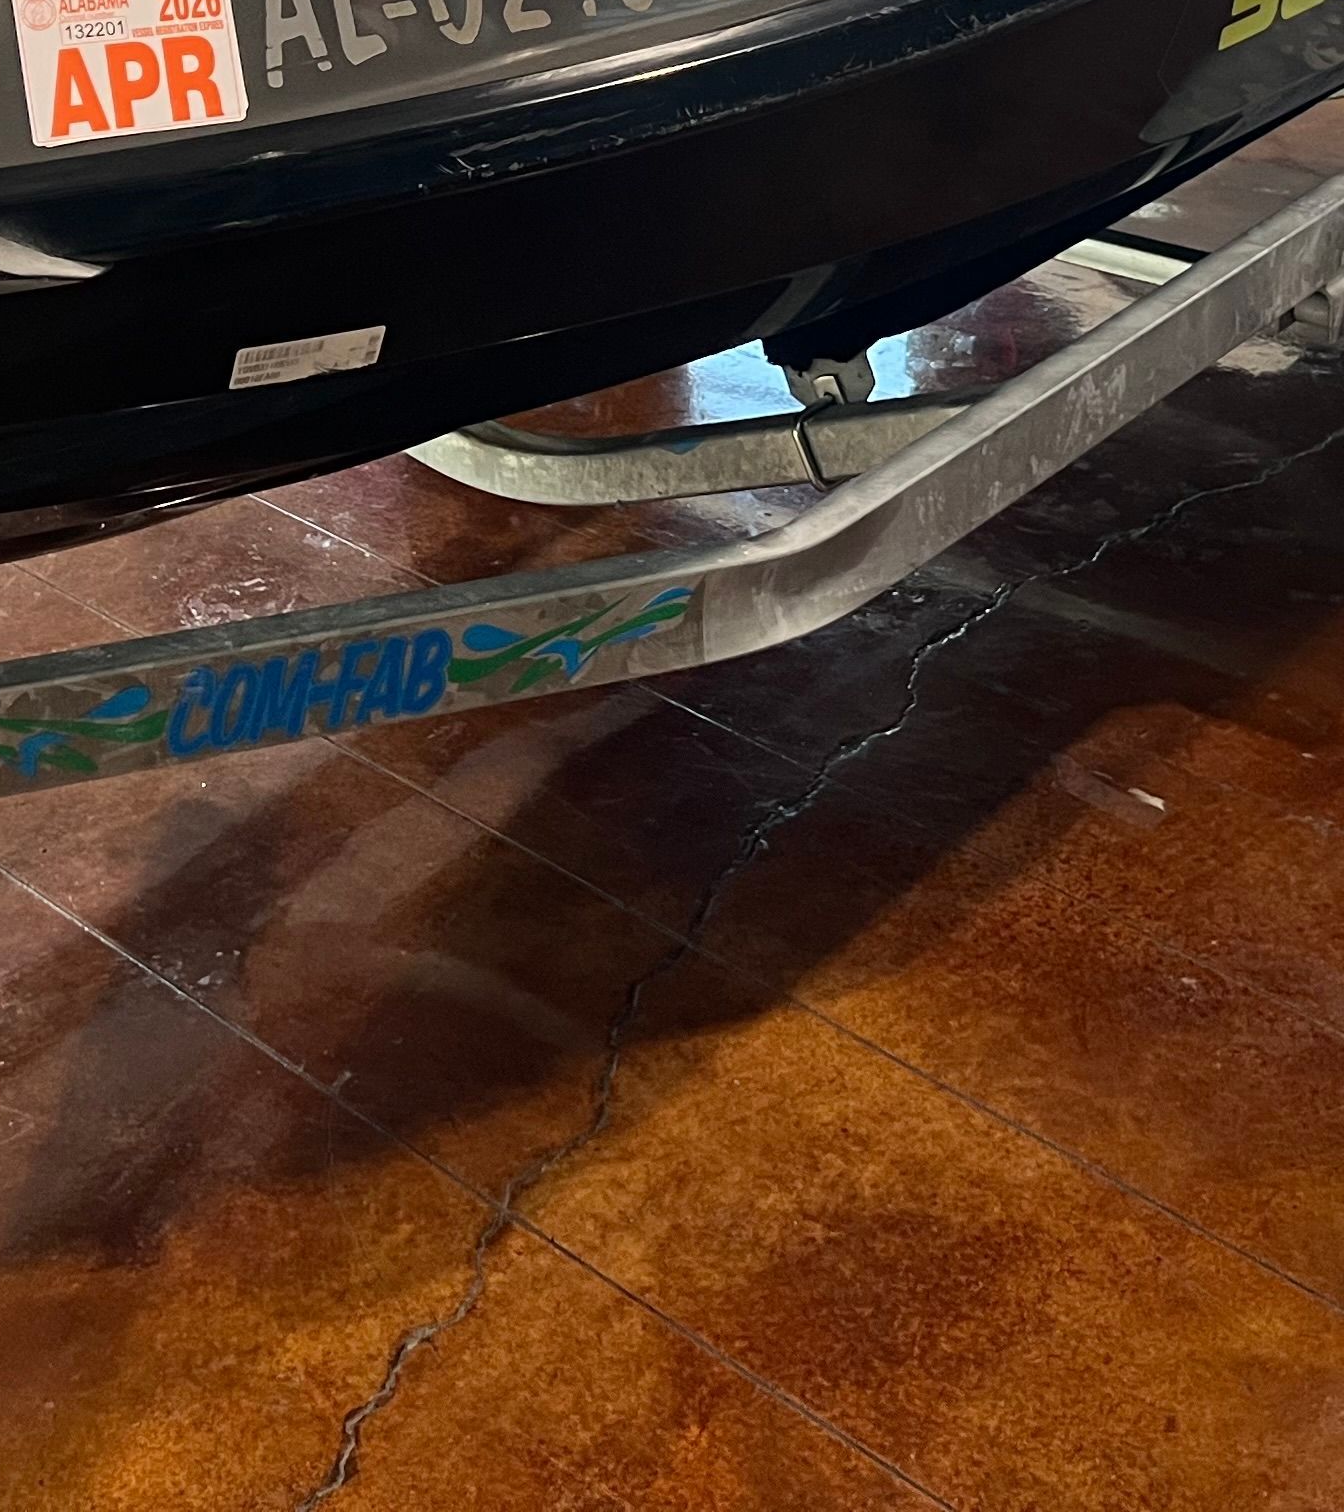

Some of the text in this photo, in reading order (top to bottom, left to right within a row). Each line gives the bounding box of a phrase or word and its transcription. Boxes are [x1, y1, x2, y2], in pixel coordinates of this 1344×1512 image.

[65, 20, 125, 40] 132201
[51, 35, 225, 138] APR
[168, 627, 453, 758] COM-FAB
